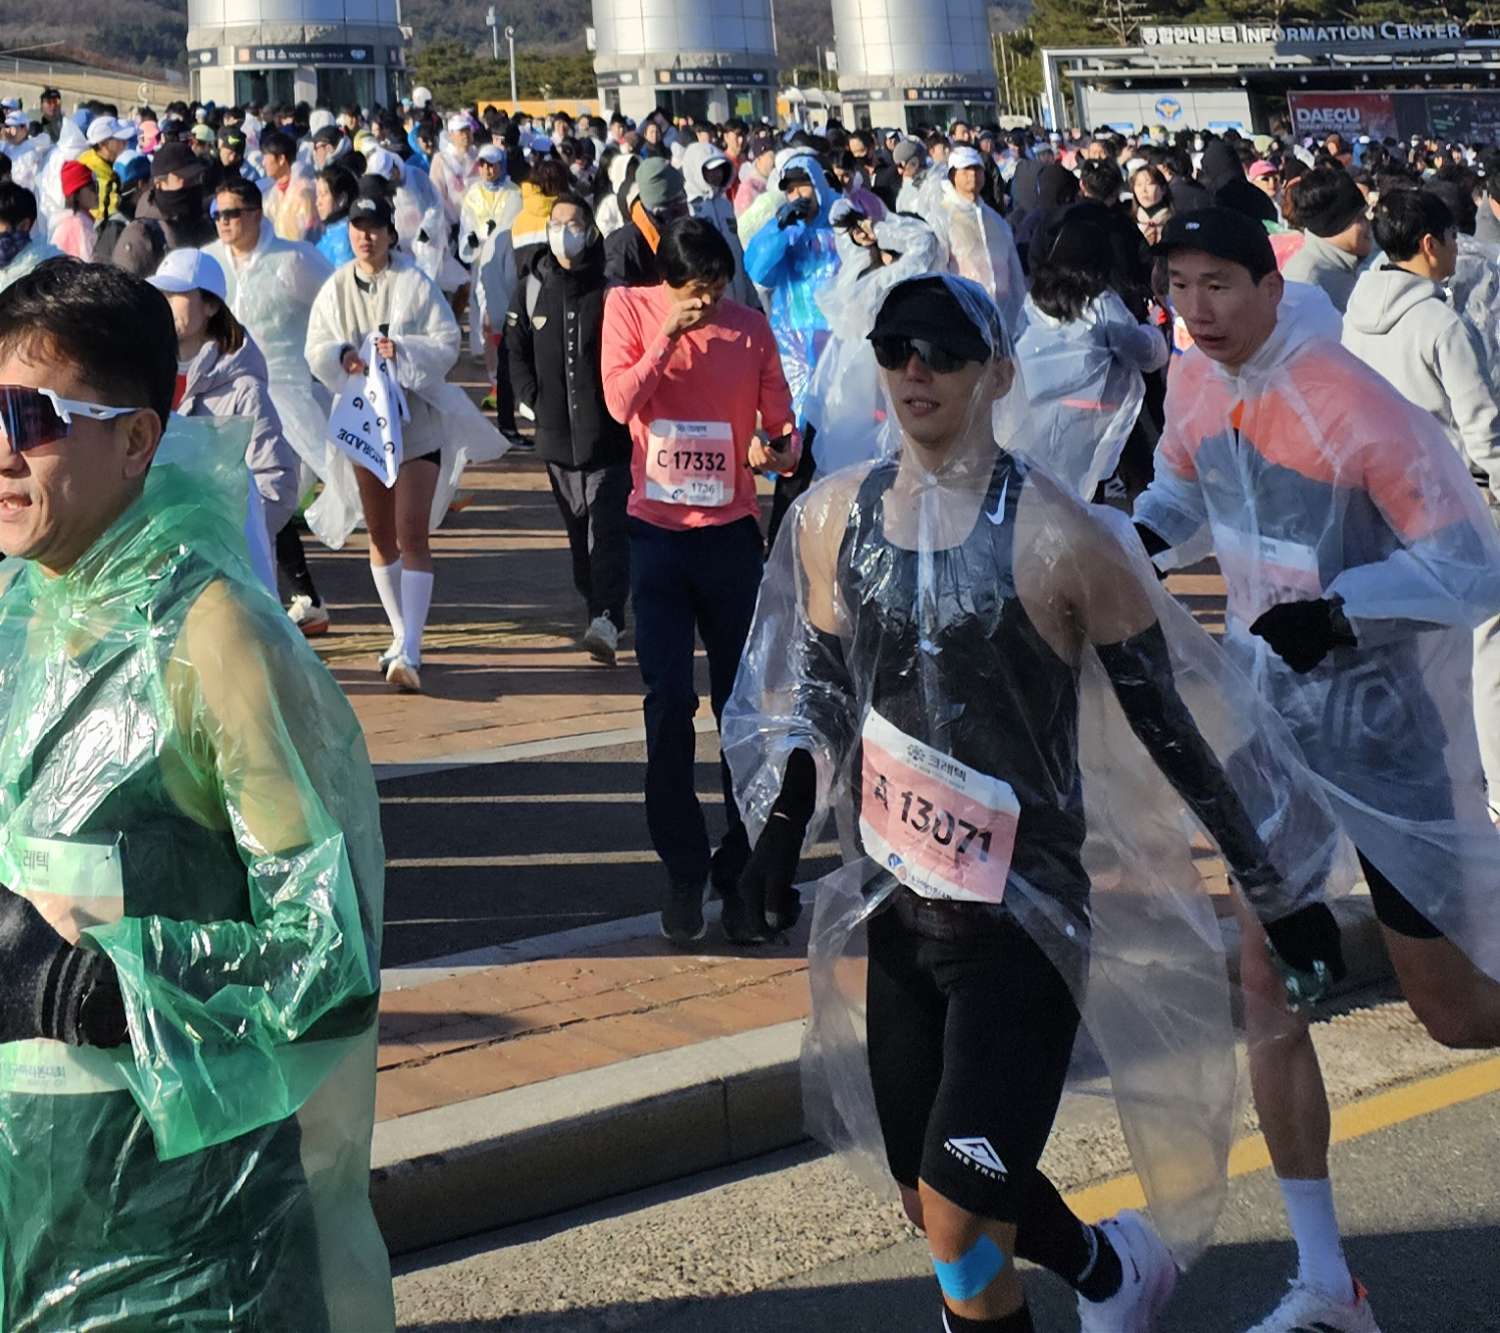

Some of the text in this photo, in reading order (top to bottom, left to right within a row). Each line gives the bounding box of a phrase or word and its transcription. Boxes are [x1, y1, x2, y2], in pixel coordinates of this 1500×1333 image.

[1241, 23, 1375, 44] INFORMATION
[1380, 20, 1462, 40] CENTER
[1296, 107, 1361, 124] DAEGU
[657, 449, 726, 471] C 17332
[901, 790, 993, 863] 13071
[13, 848, 50, 872] 레텍
